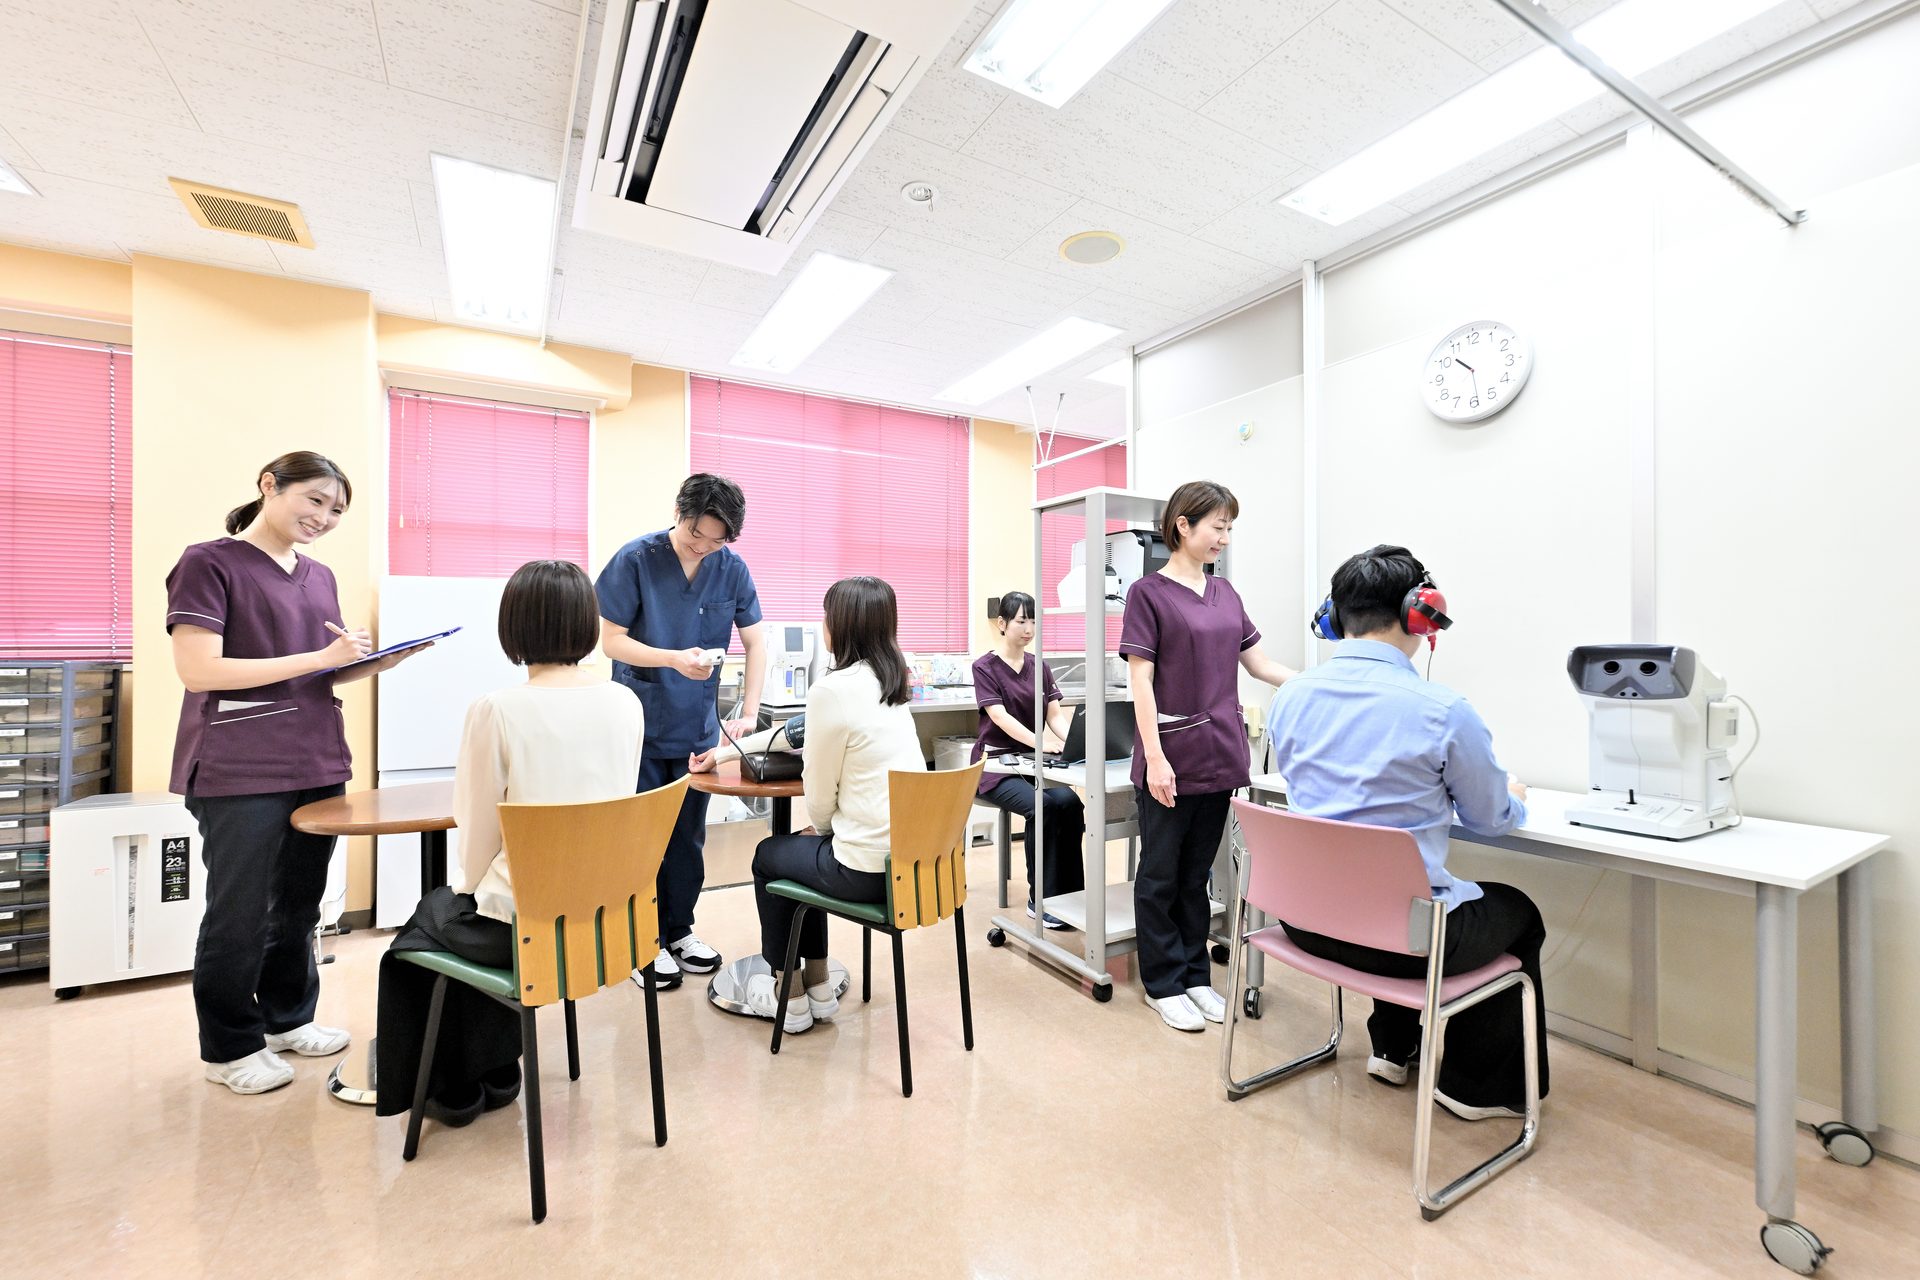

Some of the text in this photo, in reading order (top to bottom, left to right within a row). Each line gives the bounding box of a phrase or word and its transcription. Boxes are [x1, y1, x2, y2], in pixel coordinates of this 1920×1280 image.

[1466, 331, 1480, 345] 12
[1450, 342, 1461, 354] 11
[1499, 338, 1509, 352] 2
[1439, 356, 1452, 369] 10
[1504, 353, 1515, 367] 3
[1434, 374, 1444, 387] 9
[1499, 371, 1511, 384] 4
[1440, 388, 1450, 401] 8
[1487, 386, 1497, 400] 5
[1452, 395, 1461, 409] 7
[1469, 395, 1480, 408] 6
[166, 840, 186, 850] A4
[166, 857, 182, 867] 23
